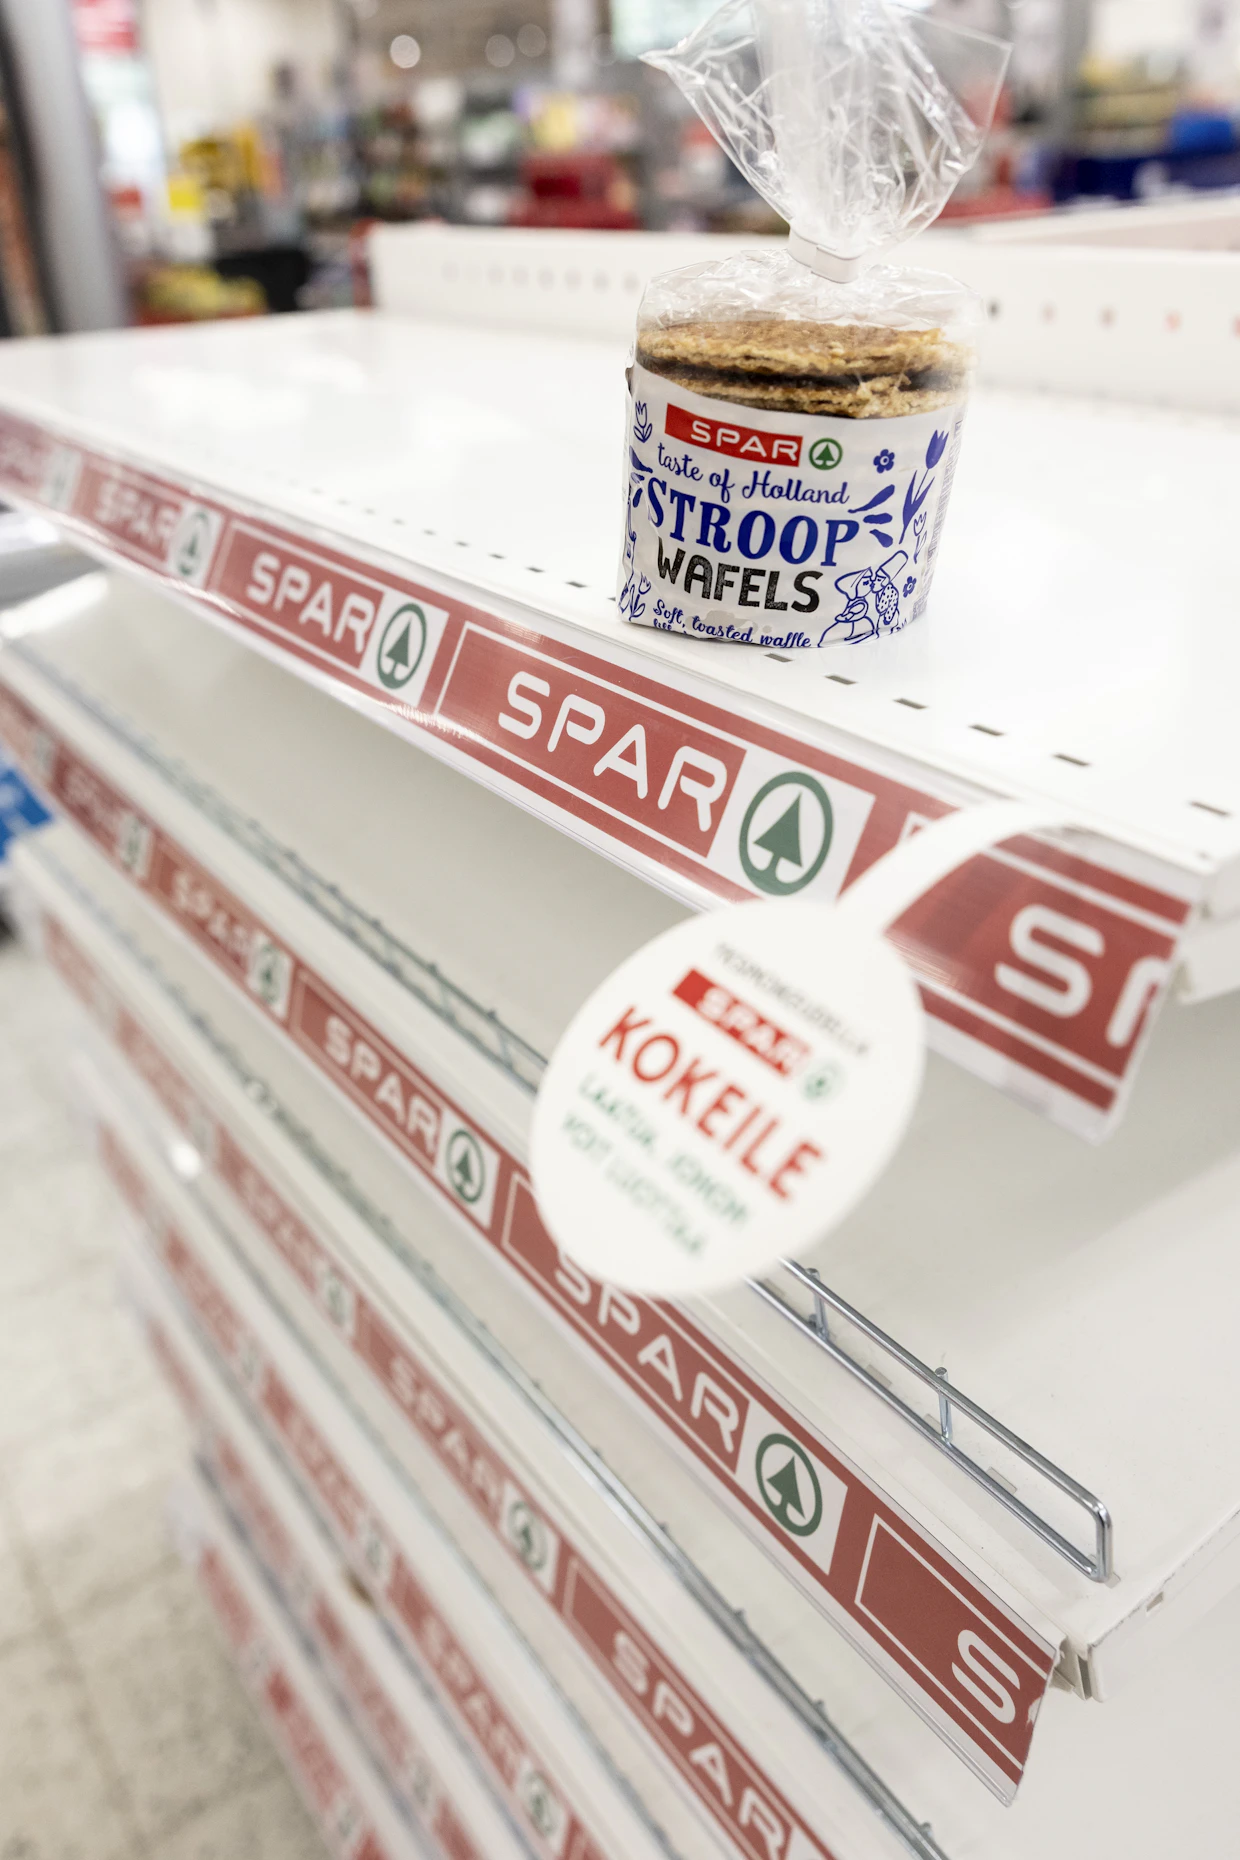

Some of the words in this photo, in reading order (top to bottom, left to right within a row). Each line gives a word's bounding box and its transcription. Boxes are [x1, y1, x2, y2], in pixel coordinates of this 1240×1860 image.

[658, 442, 703, 482] taste
[709, 468, 735, 503] of
[742, 470, 850, 505] Holland
[691, 420, 799, 462] SPAR
[647, 476, 860, 567] STROOP
[246, 552, 376, 653] SPAR
[658, 536, 824, 613] WAFELS
[653, 599, 686, 628] Soft,
[692, 616, 754, 643] toasted
[760, 632, 811, 649] waffle
[498, 670, 728, 832] SPAR
[695, 986, 806, 1071] SPAR
[325, 1016, 437, 1153] SPAR
[599, 1005, 826, 1202] KOKEILE
[555, 1250, 740, 1453] SPAR
[611, 1630, 785, 1860] SPAR
